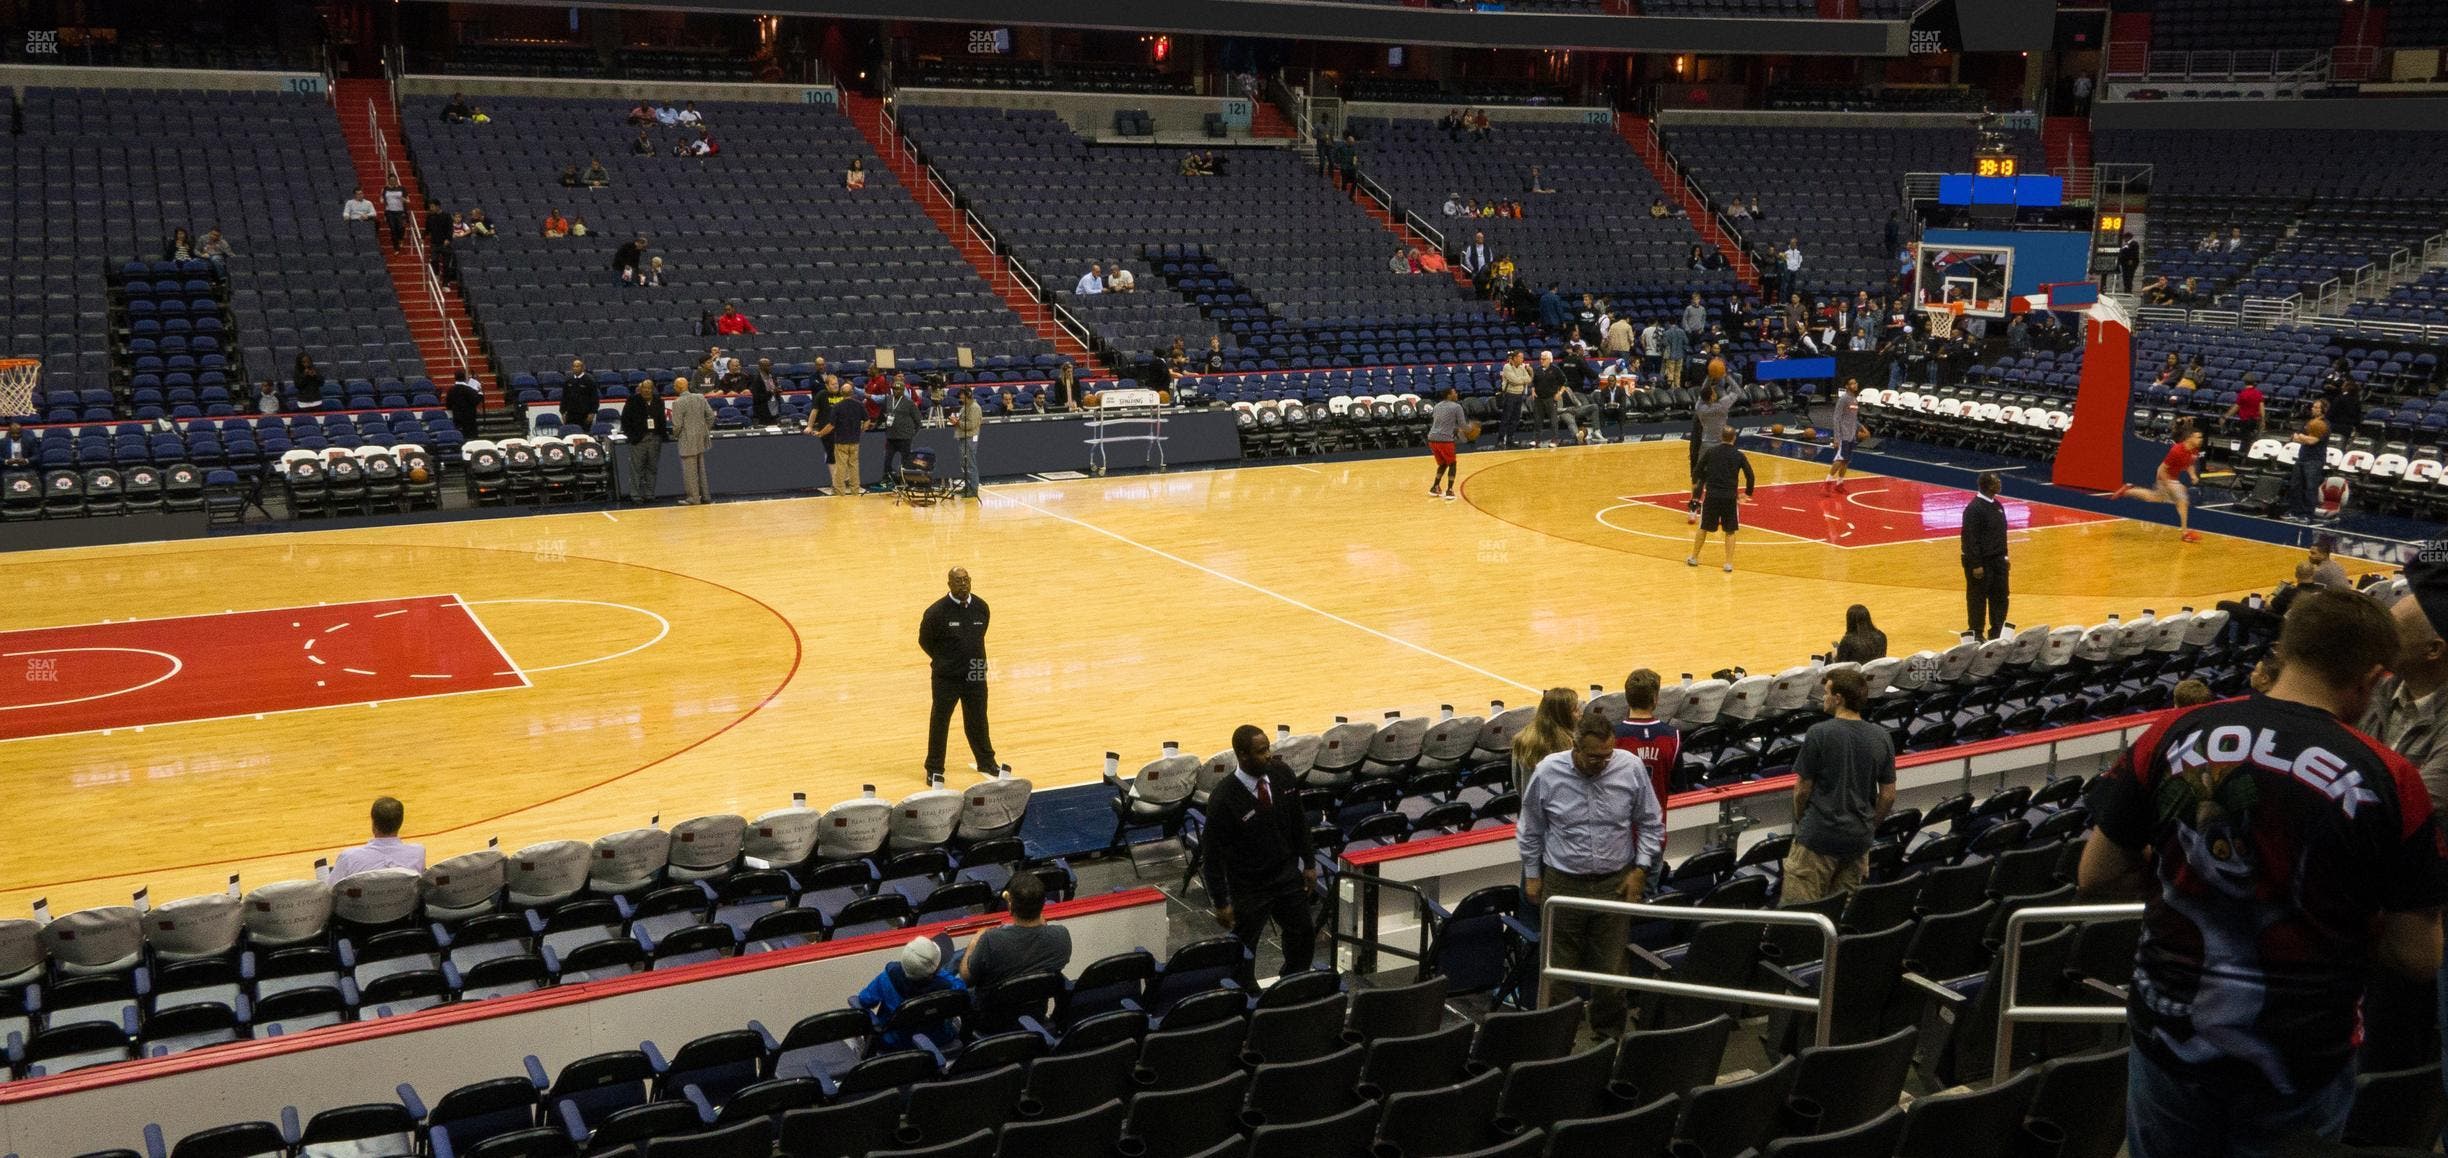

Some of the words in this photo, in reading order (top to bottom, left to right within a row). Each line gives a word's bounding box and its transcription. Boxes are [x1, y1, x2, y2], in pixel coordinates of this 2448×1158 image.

[290, 79, 317, 92] 101
[806, 91, 832, 103] 100
[1229, 103, 1246, 115] 121
[1588, 112, 1608, 123] 120
[1979, 159, 2013, 175] 39:13
[1637, 746, 1660, 761] WALL
